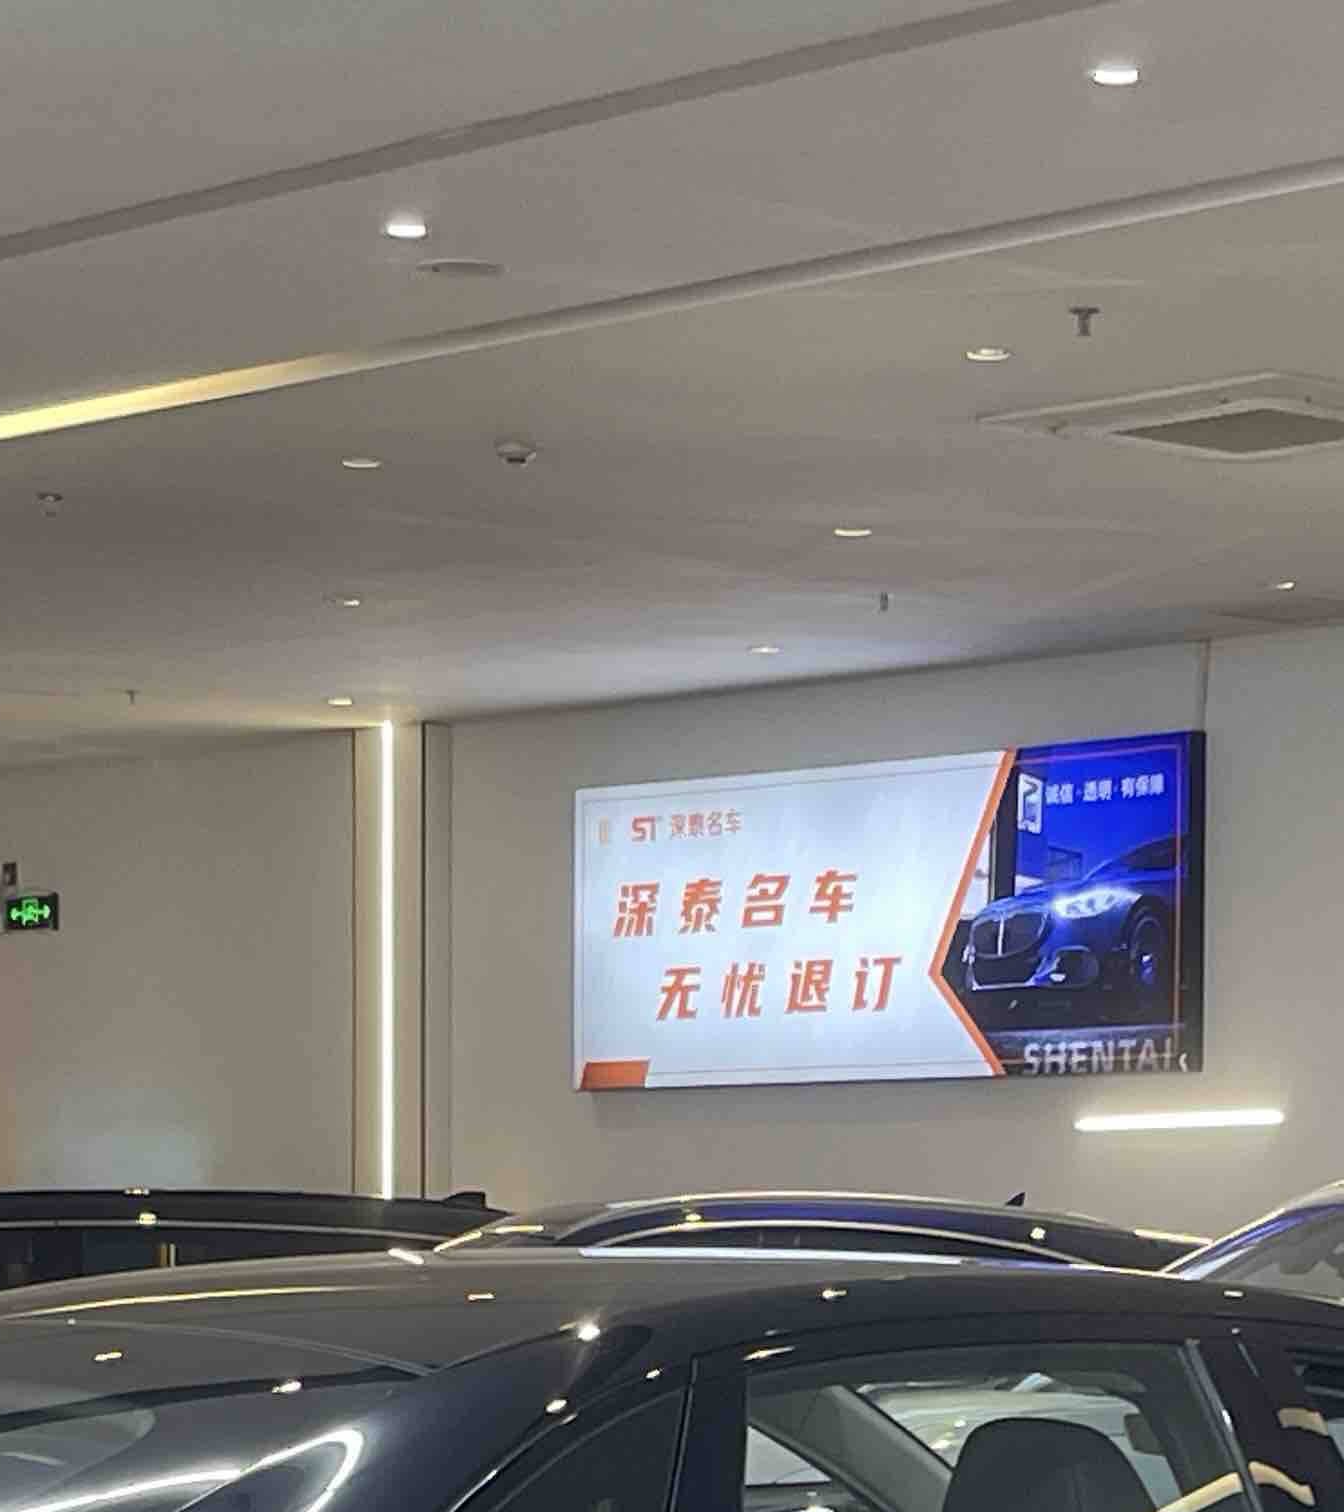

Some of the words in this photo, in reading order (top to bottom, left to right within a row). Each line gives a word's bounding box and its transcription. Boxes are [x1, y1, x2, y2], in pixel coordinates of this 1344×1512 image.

[613, 870, 858, 938] 深泰名车
[655, 955, 902, 1022] 无忧退订
